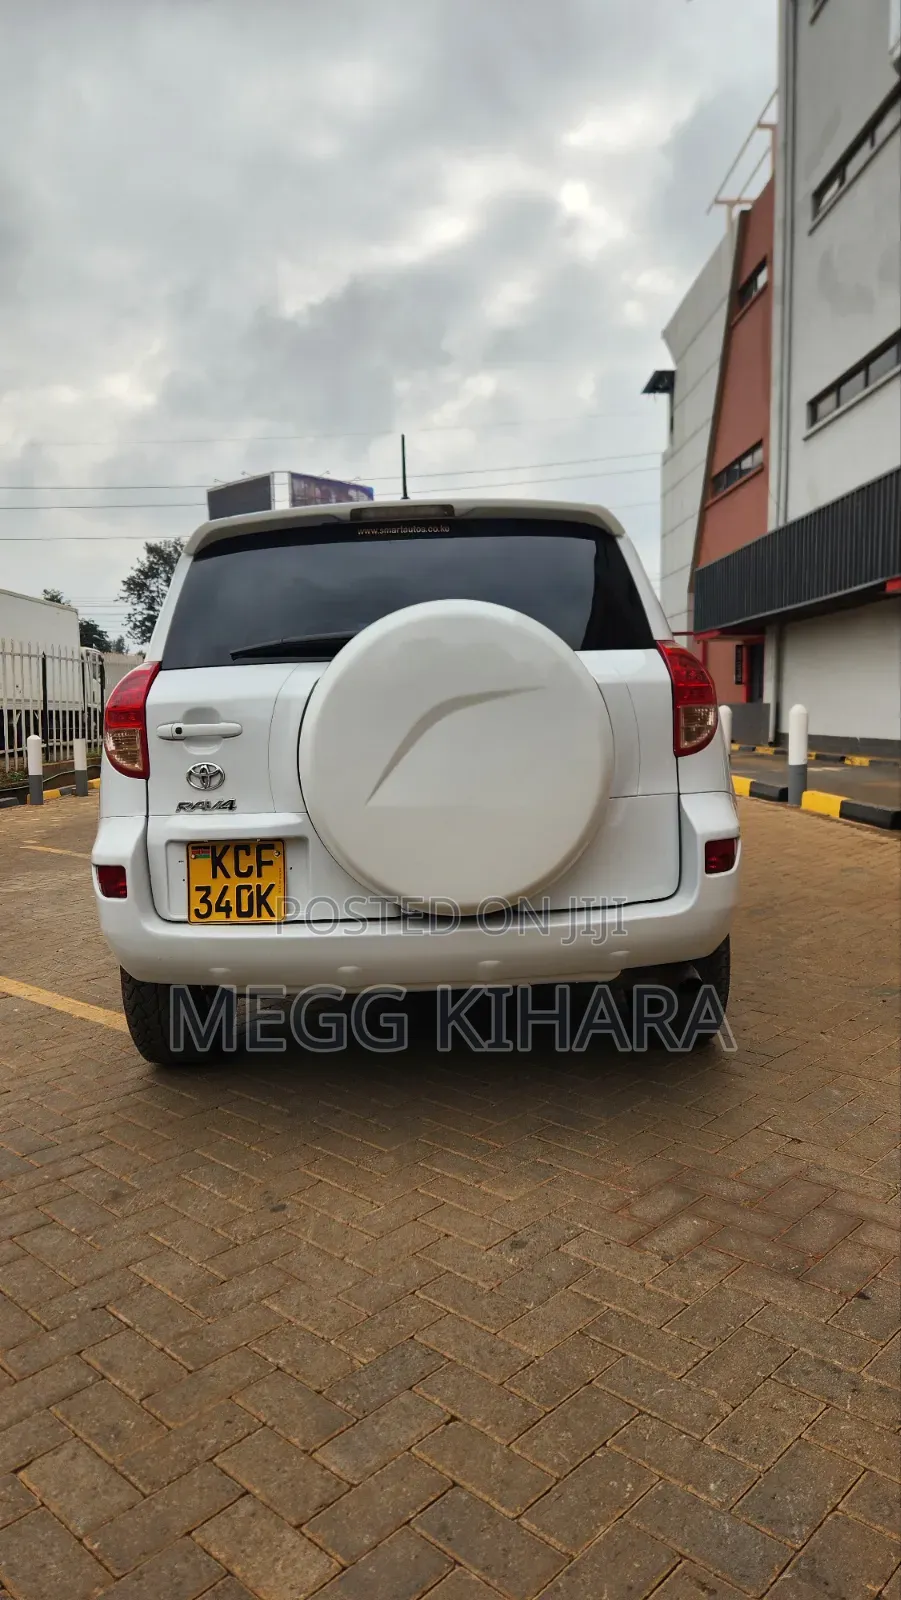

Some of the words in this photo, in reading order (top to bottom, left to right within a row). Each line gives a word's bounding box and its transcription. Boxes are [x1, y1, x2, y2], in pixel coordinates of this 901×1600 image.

[176, 798, 237, 813] RAV4
[211, 844, 275, 879] KCF
[194, 884, 276, 919] 340K
